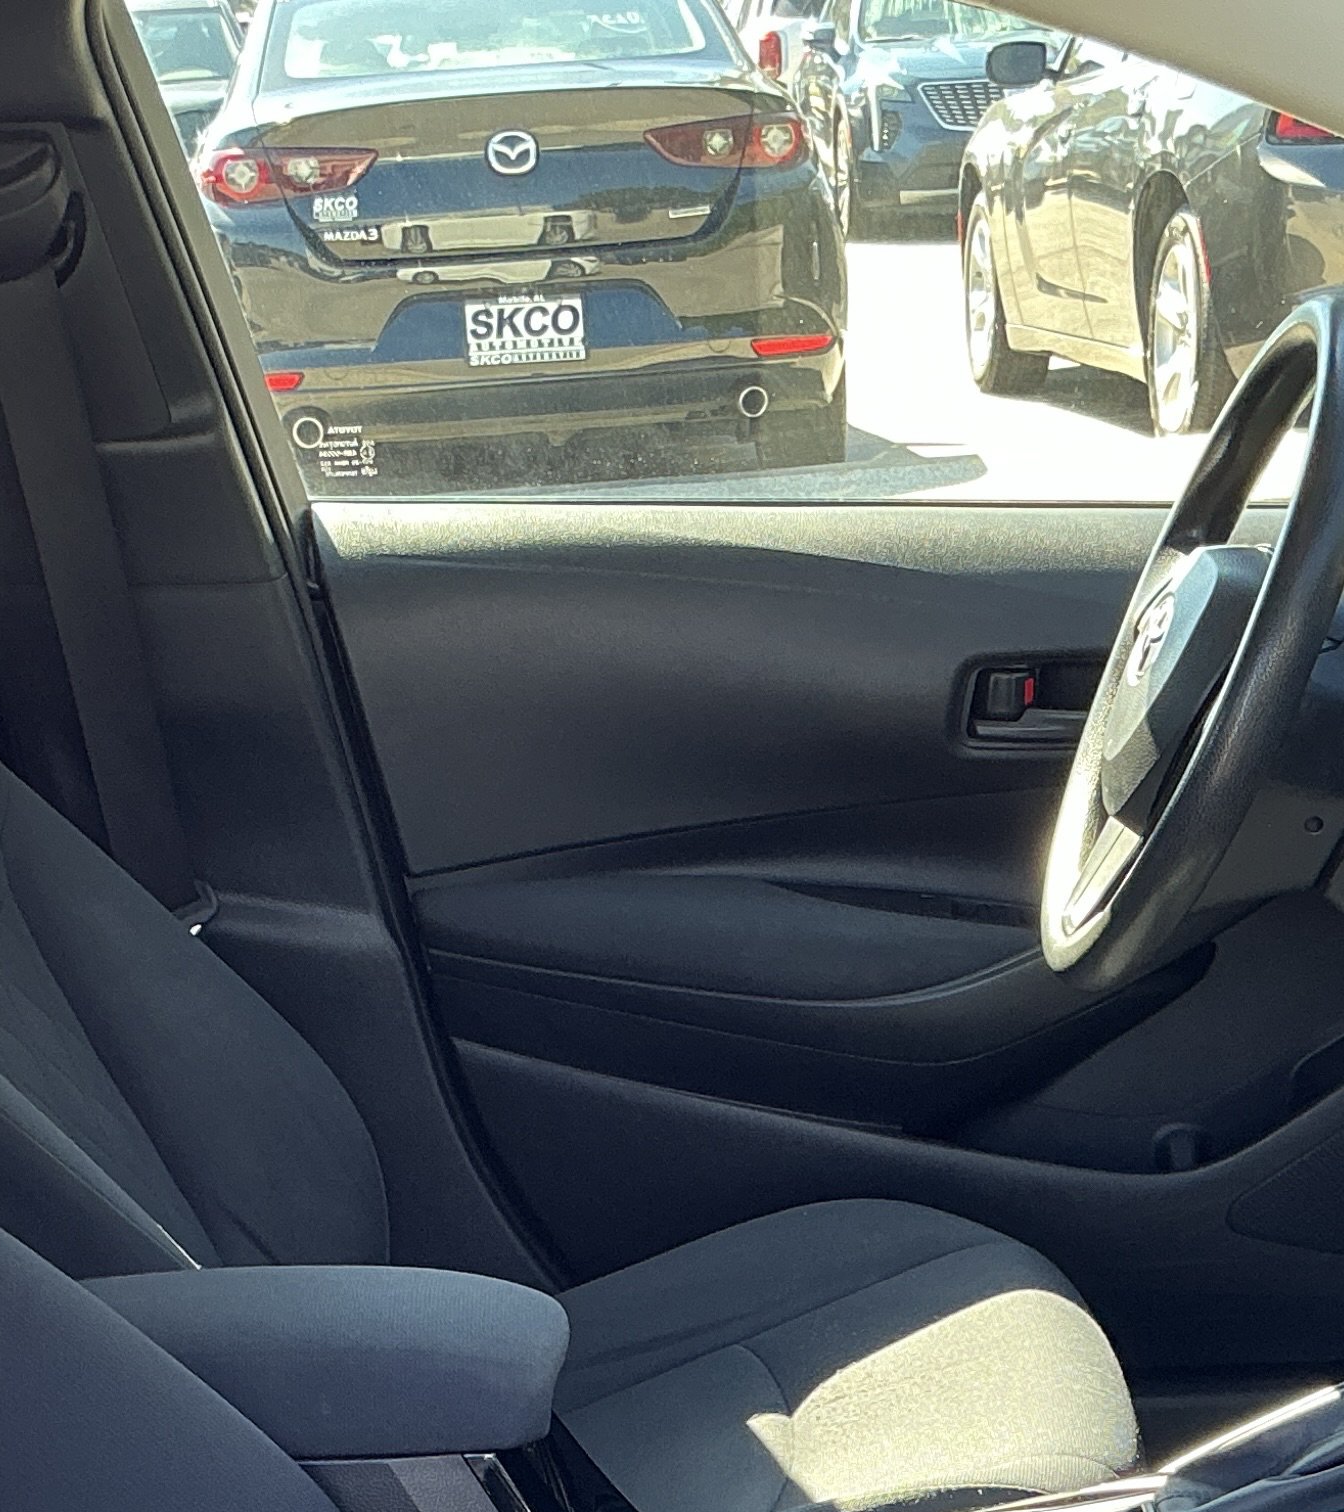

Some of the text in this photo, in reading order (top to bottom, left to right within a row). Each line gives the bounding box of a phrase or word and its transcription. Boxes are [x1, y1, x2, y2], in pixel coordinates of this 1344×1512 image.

[312, 196, 359, 213] SKCO
[469, 303, 581, 340] SKCO
[469, 354, 513, 367] SKCO
